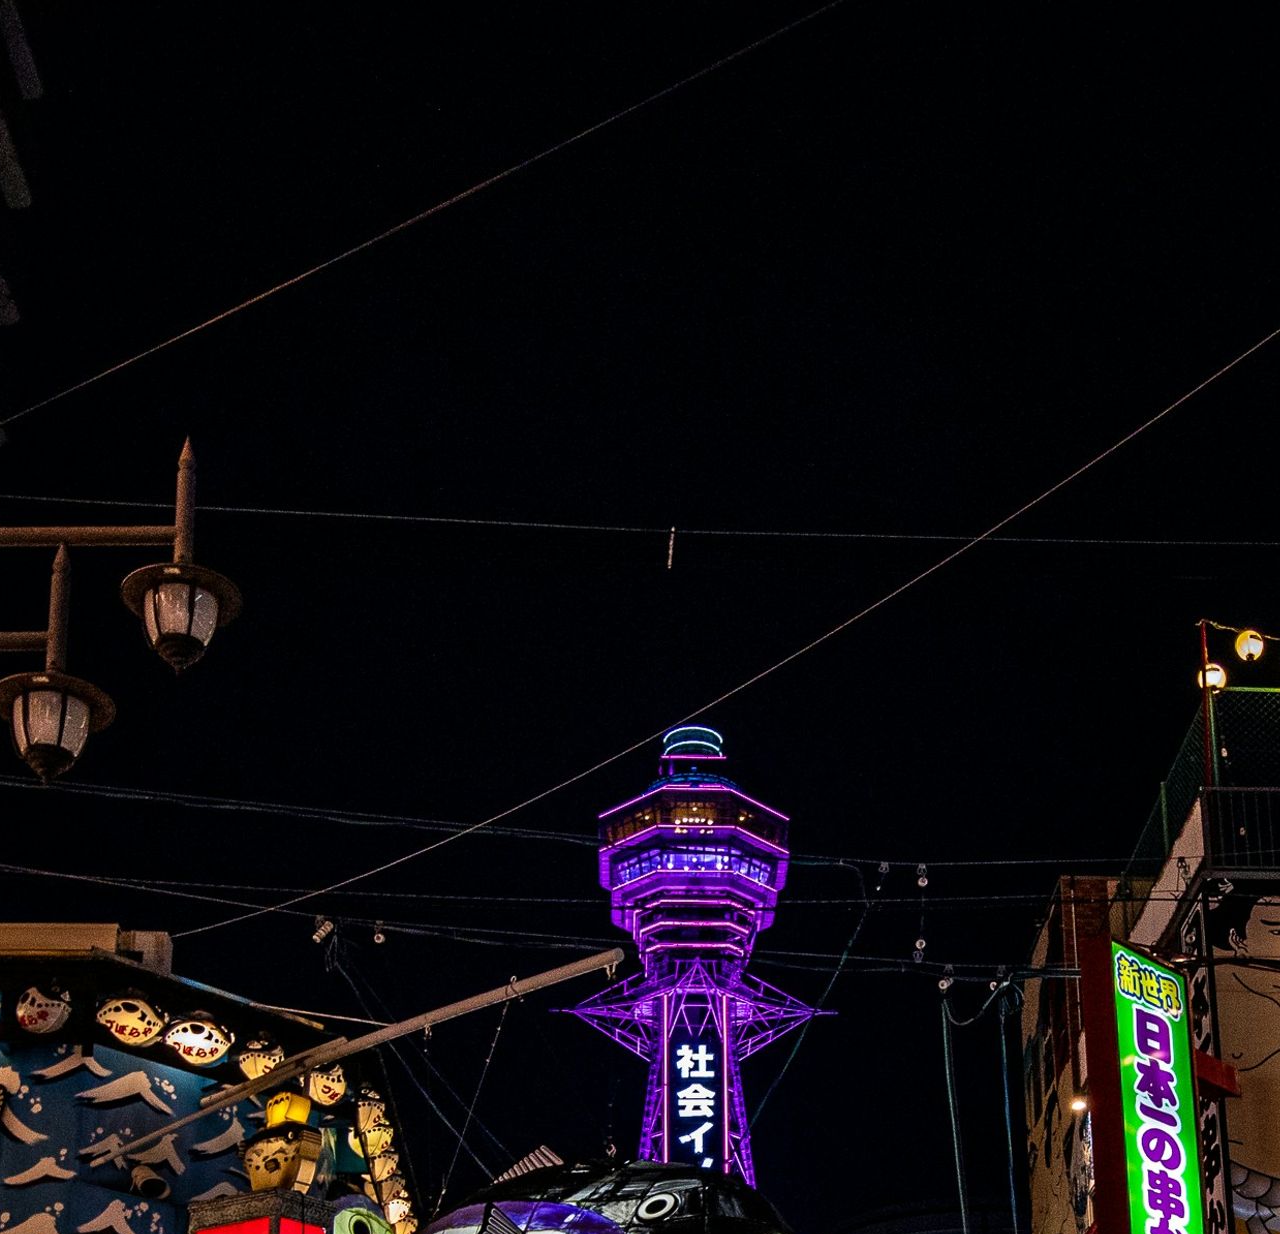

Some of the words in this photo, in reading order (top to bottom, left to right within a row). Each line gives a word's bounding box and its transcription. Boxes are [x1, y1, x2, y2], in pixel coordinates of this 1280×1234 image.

[1116, 957, 1181, 1016] 新世界
[676, 1044, 715, 1168] 社会イ
